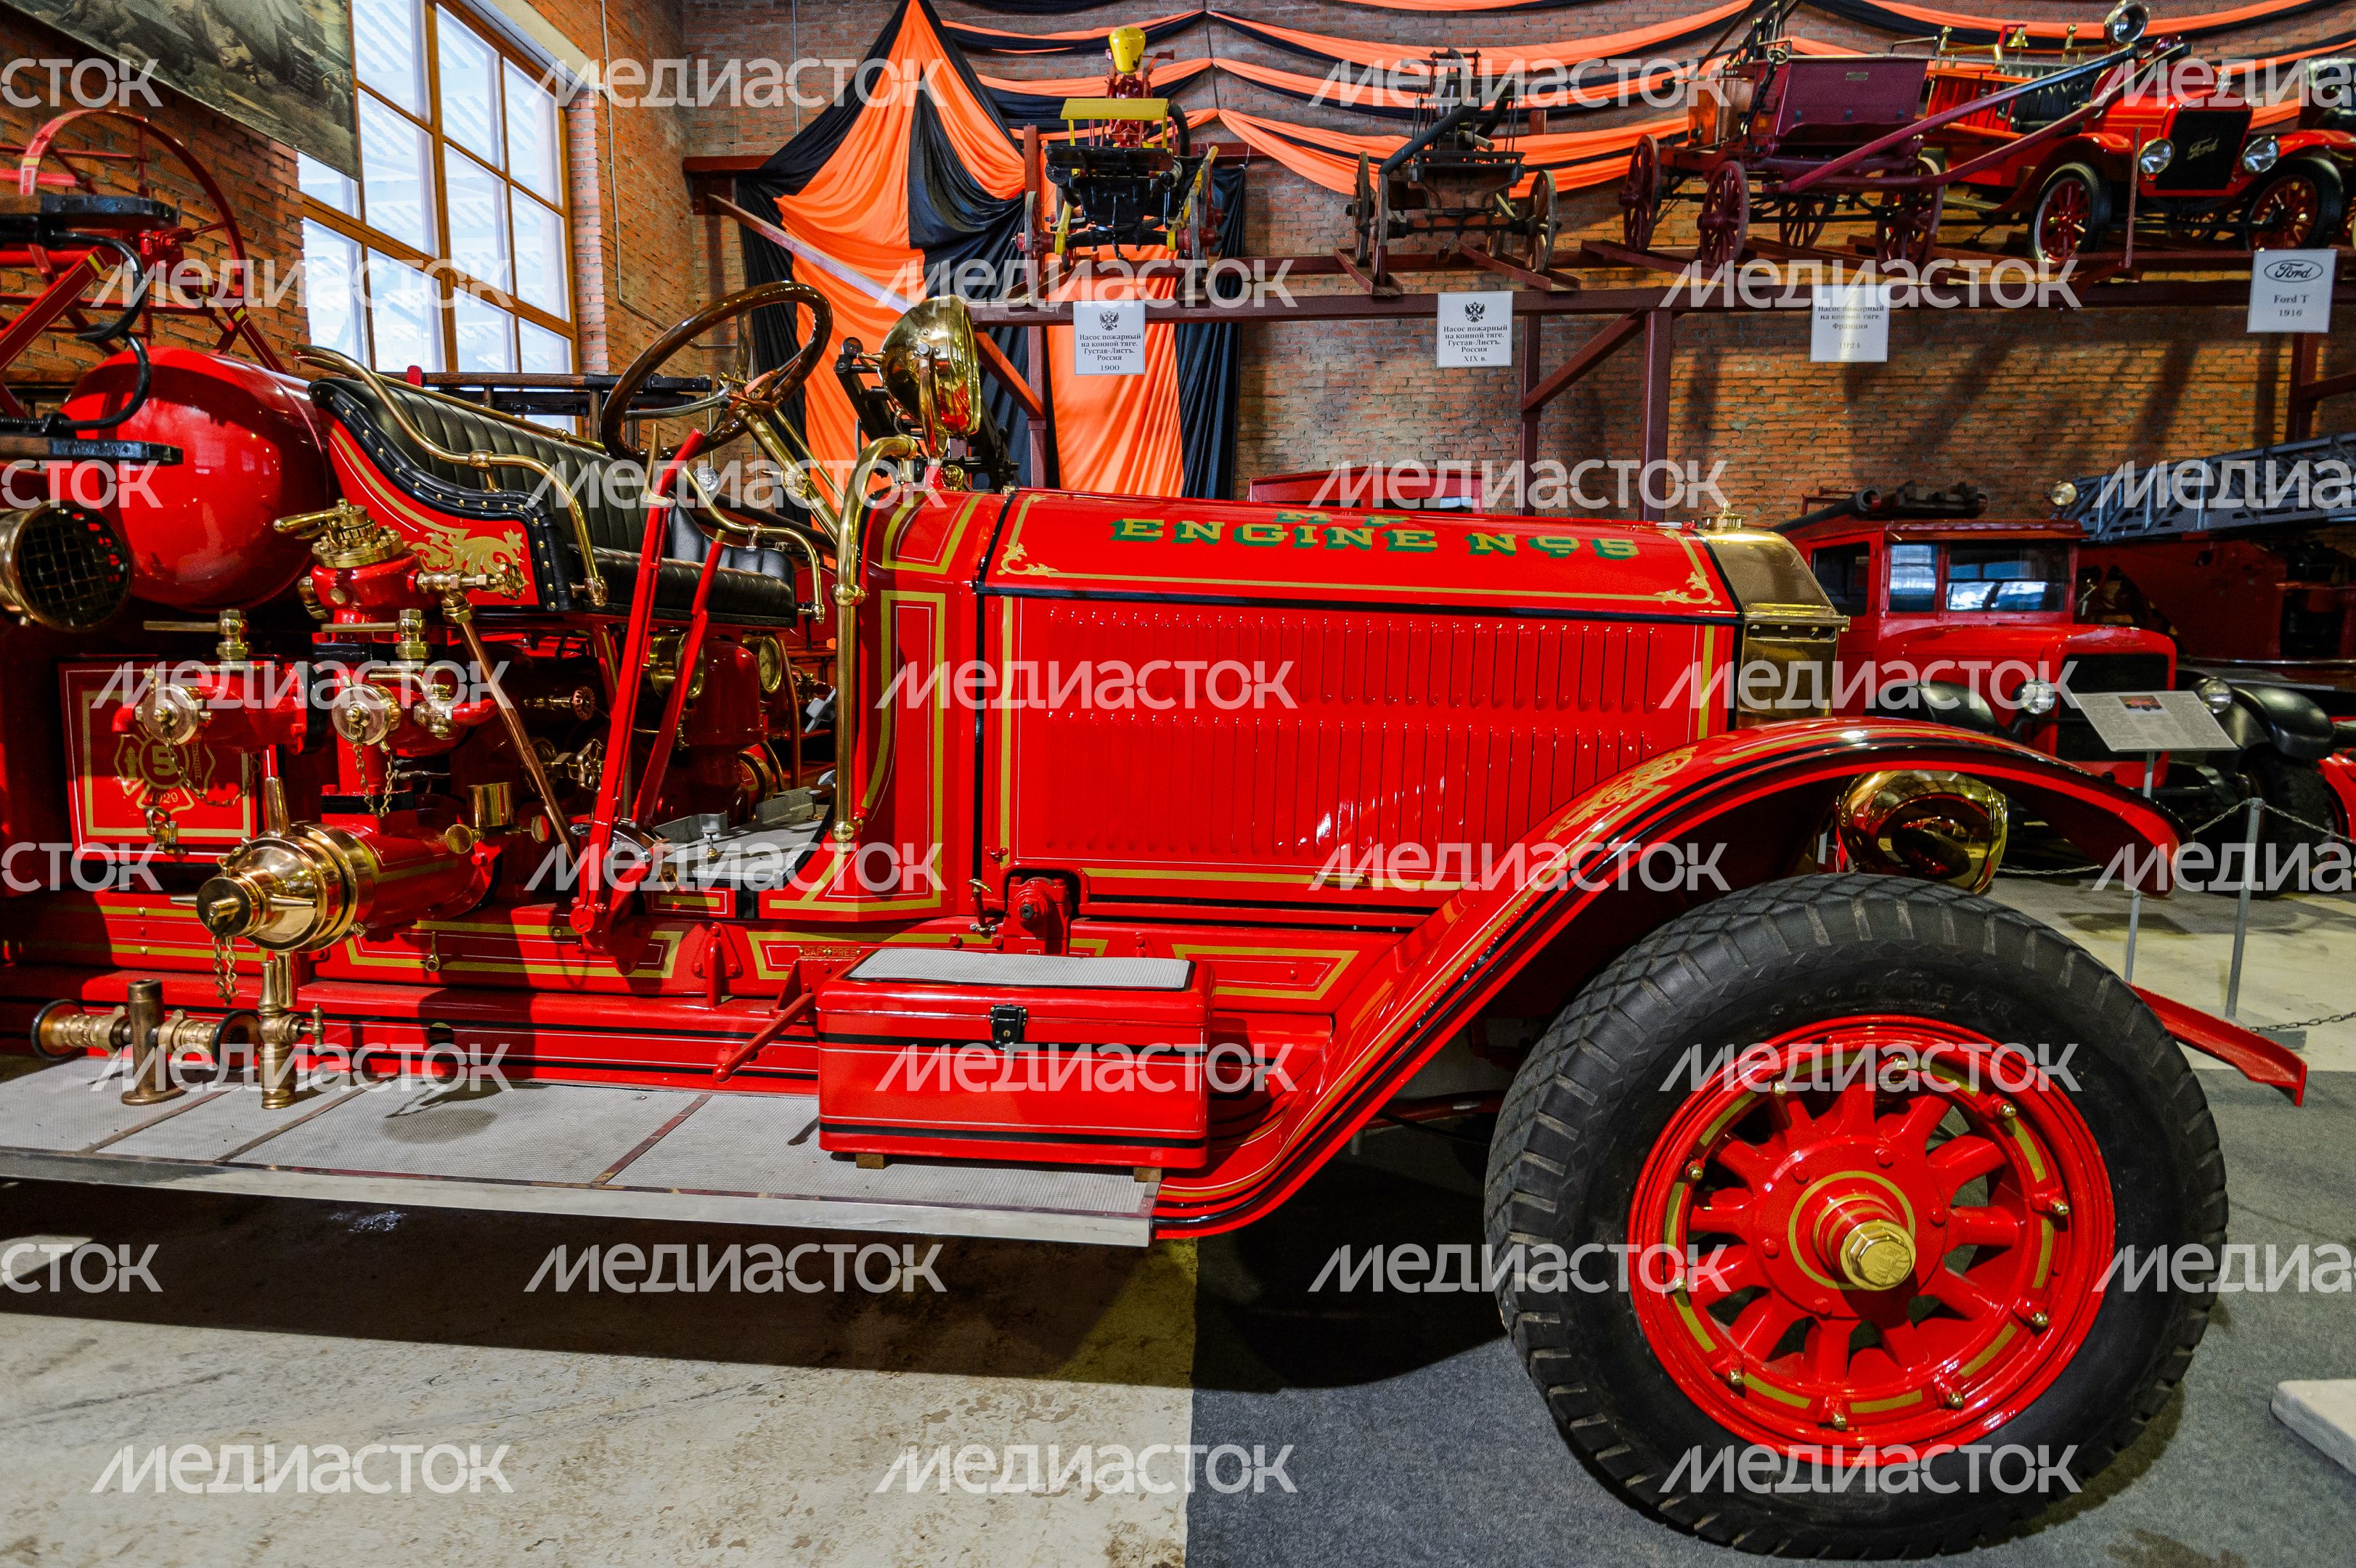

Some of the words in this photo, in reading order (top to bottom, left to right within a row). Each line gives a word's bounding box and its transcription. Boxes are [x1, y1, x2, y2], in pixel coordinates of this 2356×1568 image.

[2275, 262, 2313, 278] Ford
[2274, 295, 2297, 303] Ford
[2300, 294, 2310, 303] T
[1467, 324, 1508, 333] пожарный
[1110, 518, 1438, 553] ENGINE
[151, 745, 178, 776] 5
